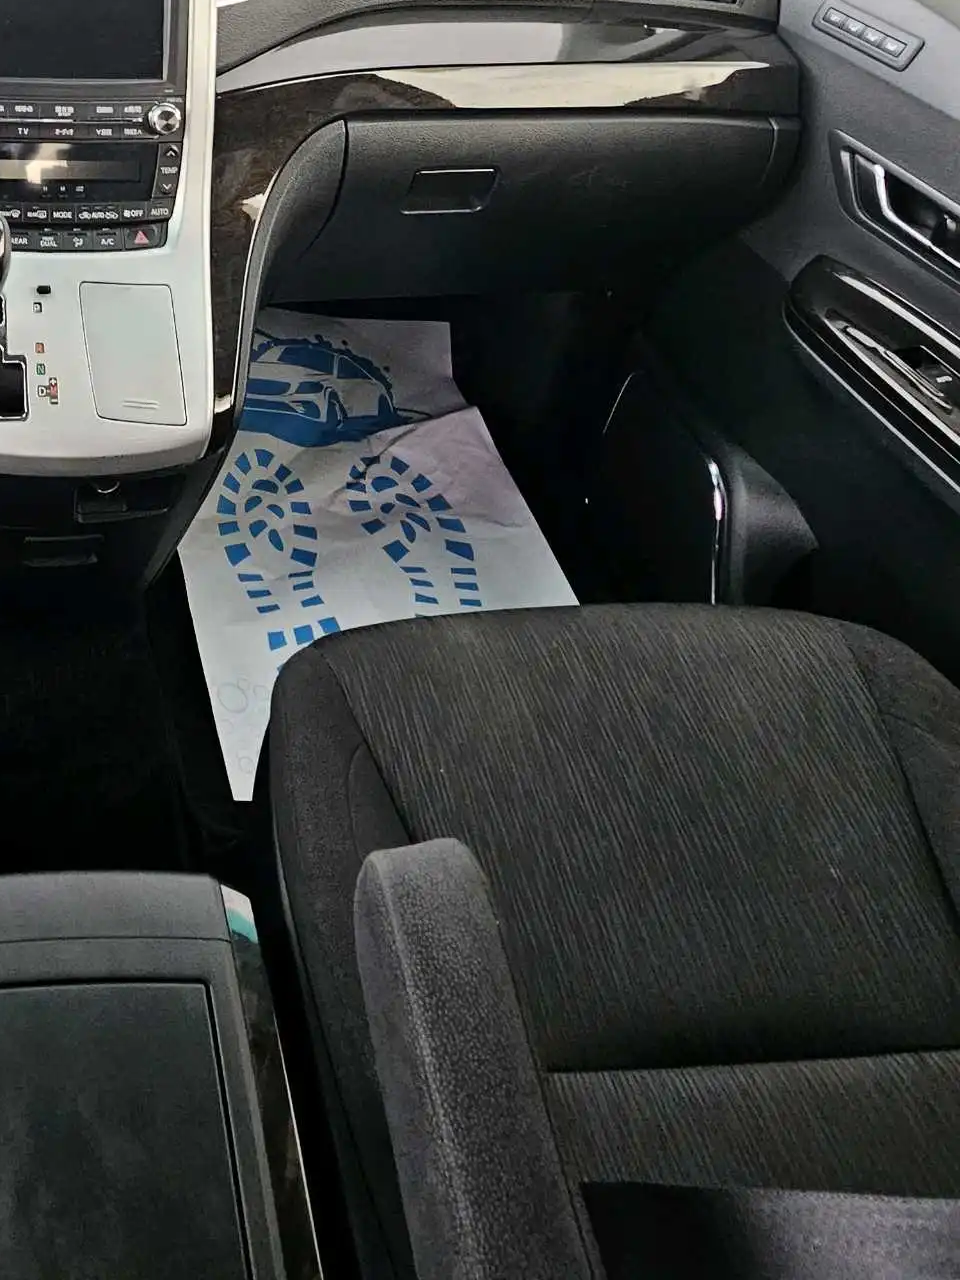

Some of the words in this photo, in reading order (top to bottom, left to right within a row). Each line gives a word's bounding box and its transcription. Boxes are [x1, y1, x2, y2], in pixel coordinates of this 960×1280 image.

[53, 211, 73, 219] MODE
[130, 209, 144, 217] OFF
[150, 207, 169, 216] AUTO
[100, 238, 116, 246] A/C
[38, 385, 47, 397] D
